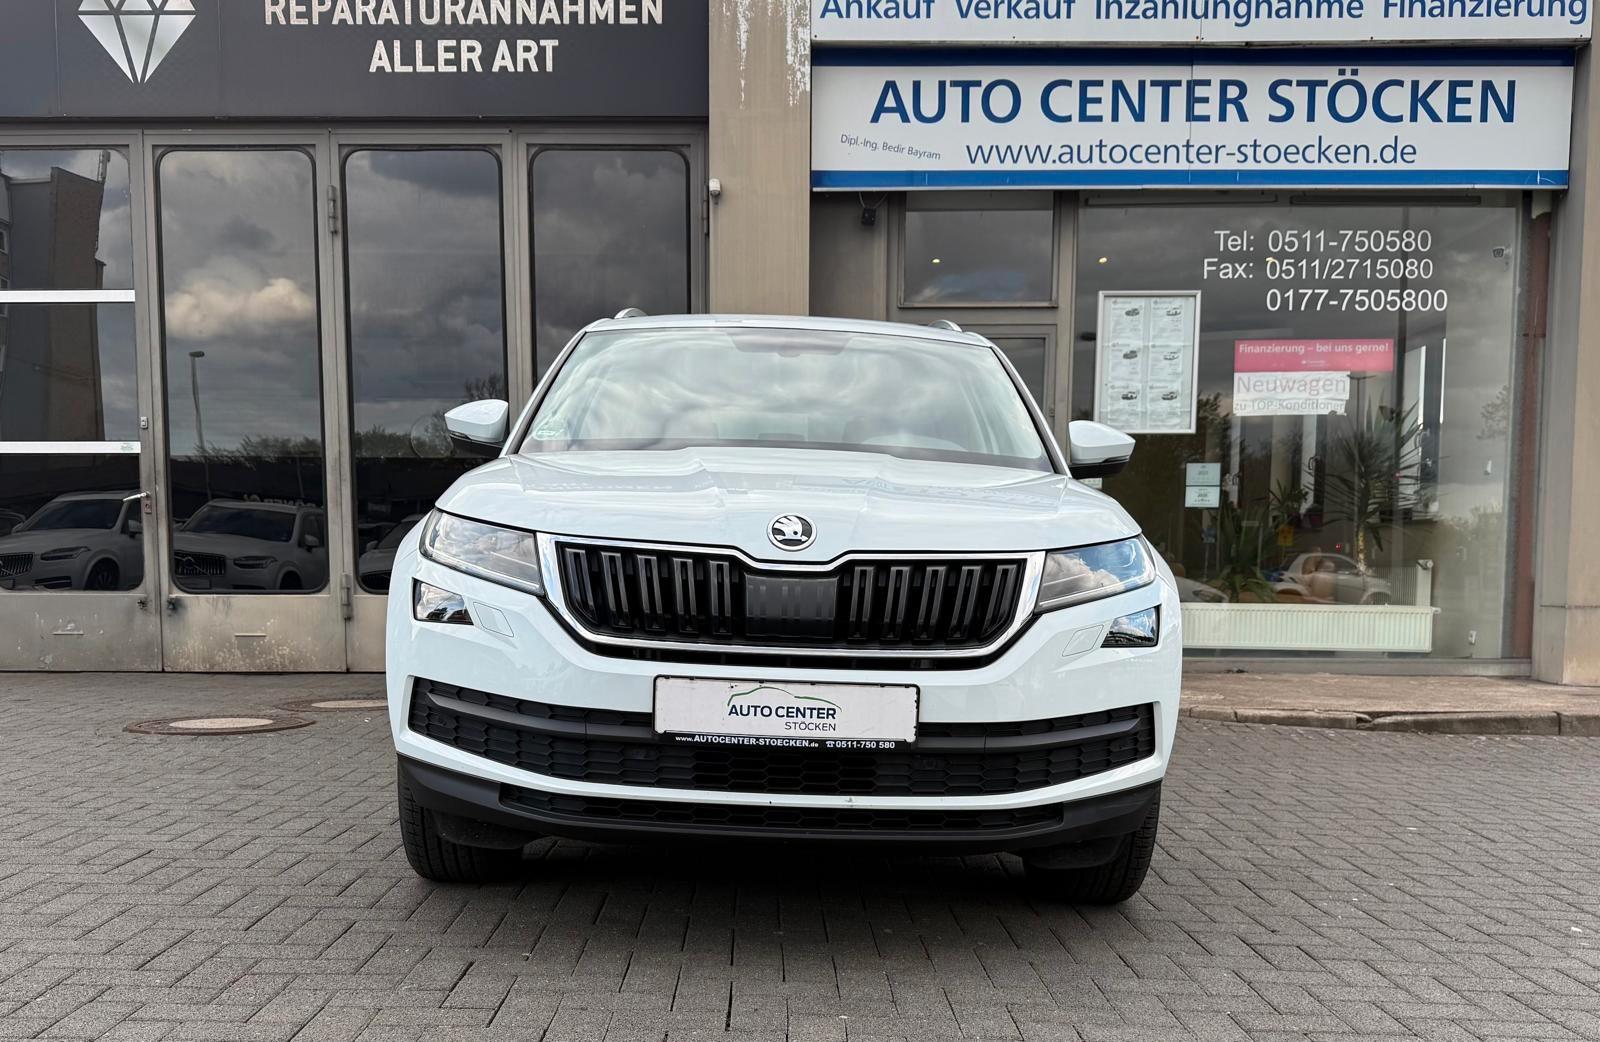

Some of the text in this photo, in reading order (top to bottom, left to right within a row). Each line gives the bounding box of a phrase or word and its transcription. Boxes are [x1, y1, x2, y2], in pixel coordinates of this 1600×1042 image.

[264, 0, 664, 25] REPARATURANNAHMEN
[820, 0, 1587, 27] Ankauf Verkauf Inzahlungnahme Finanzierung
[369, 39, 559, 73] ALLER ART
[869, 68, 1516, 124] AUTO CENTER STÖCKEN
[840, 134, 941, 160] Dipl.-Ing. Bedir Bayram
[966, 136, 1417, 165] www.autocenter-stoecken.de
[1214, 230, 1432, 253] Tel: 0511-750580
[1203, 258, 1434, 280] Fax: 0511/2715080
[1266, 289, 1448, 311] 0177-7505800
[1239, 343, 1305, 355] Finanzierung
[1335, 344, 1353, 353] uns
[1237, 375, 1347, 397] Neuwagen
[728, 704, 836, 719] AUTO CENTER
[784, 721, 836, 731] STÖCKEN
[835, 740, 877, 749] 0511-750
[878, 741, 895, 749] 580
